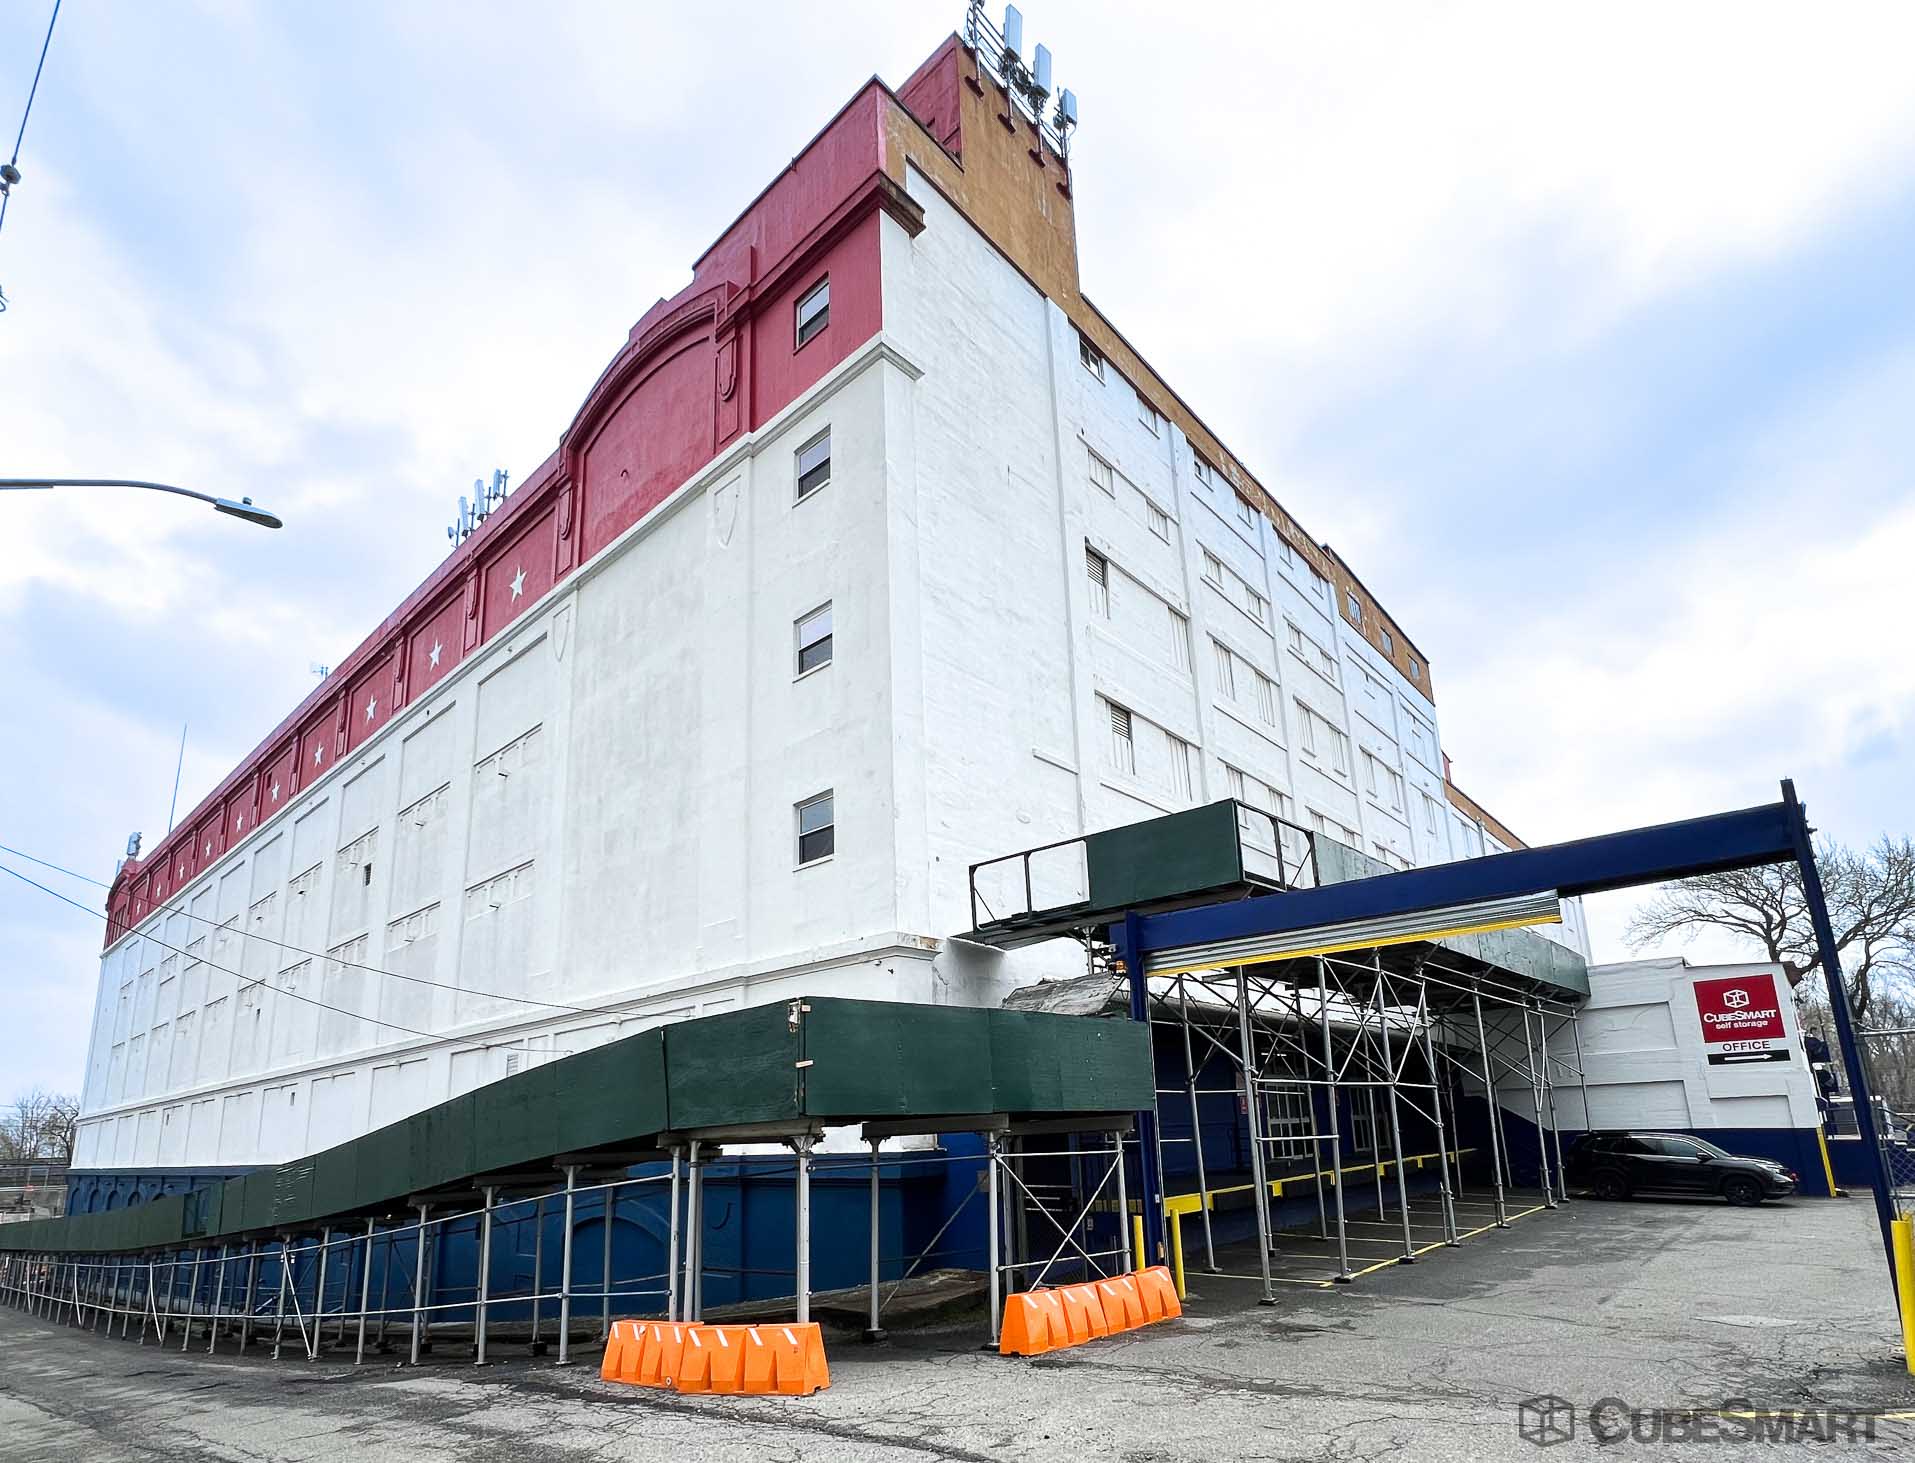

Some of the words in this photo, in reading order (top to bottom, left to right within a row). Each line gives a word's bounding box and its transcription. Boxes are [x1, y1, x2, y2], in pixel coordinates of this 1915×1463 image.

[1715, 1021, 1732, 1030] self
[1733, 1020, 1769, 1028] storage
[1722, 1040, 1771, 1052] OFFICE
